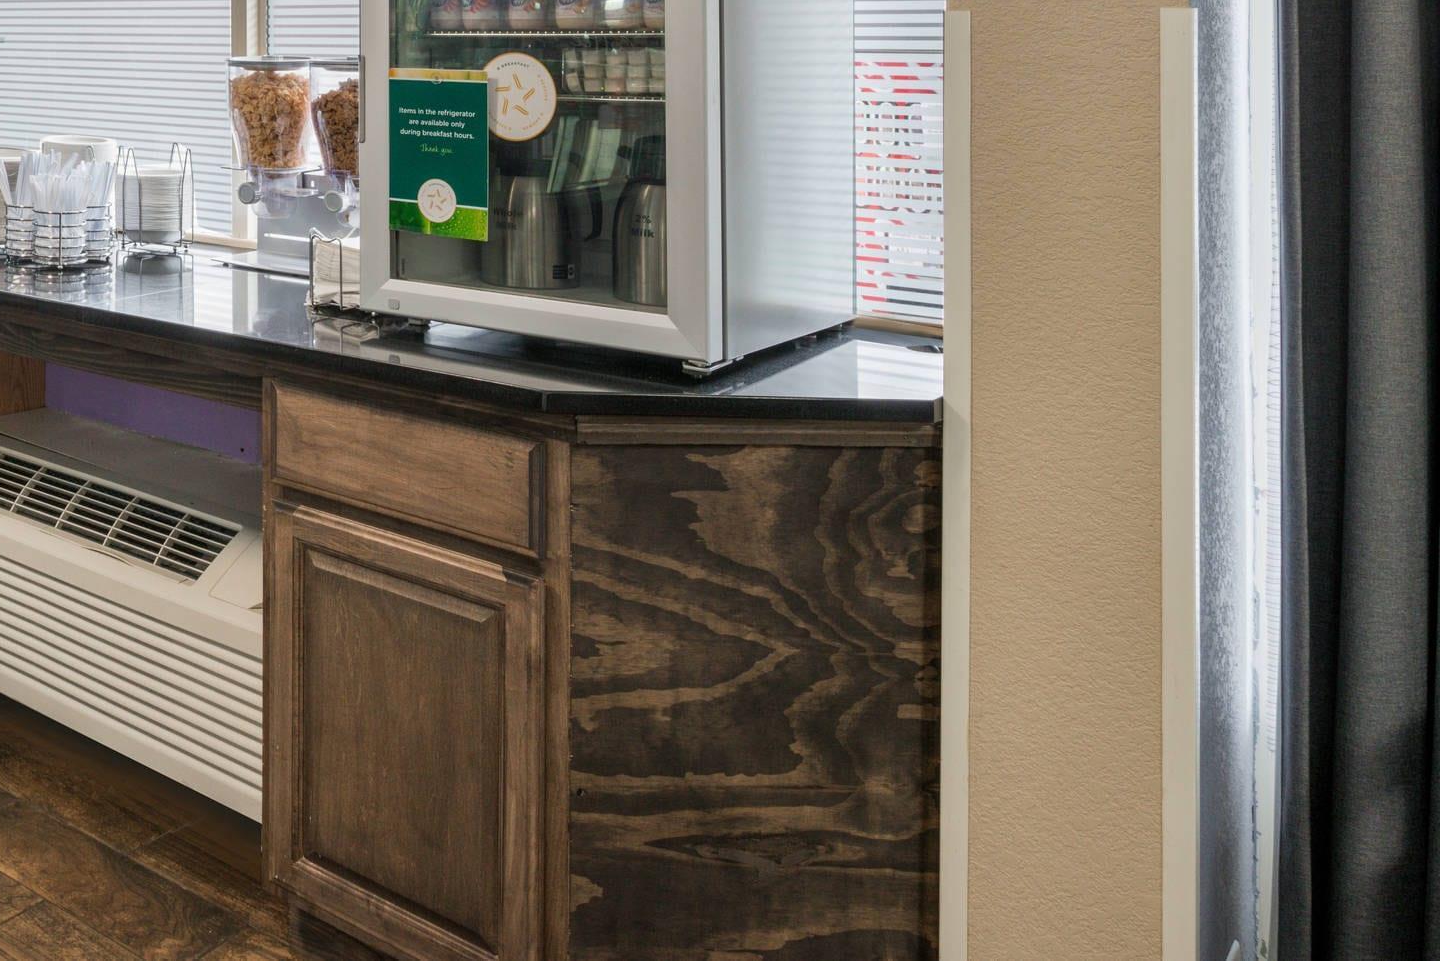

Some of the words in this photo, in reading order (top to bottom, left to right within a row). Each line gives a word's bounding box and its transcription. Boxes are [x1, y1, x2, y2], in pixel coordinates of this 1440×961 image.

[437, 109, 476, 117] refrigerator
[420, 119, 449, 127] available
[450, 121, 465, 129] only
[399, 128, 421, 137] during
[422, 129, 453, 138] breakfast
[453, 131, 475, 139] hours.
[420, 143, 438, 152] Thank
[635, 214, 652, 223] 2%
[632, 227, 655, 238] Milk
